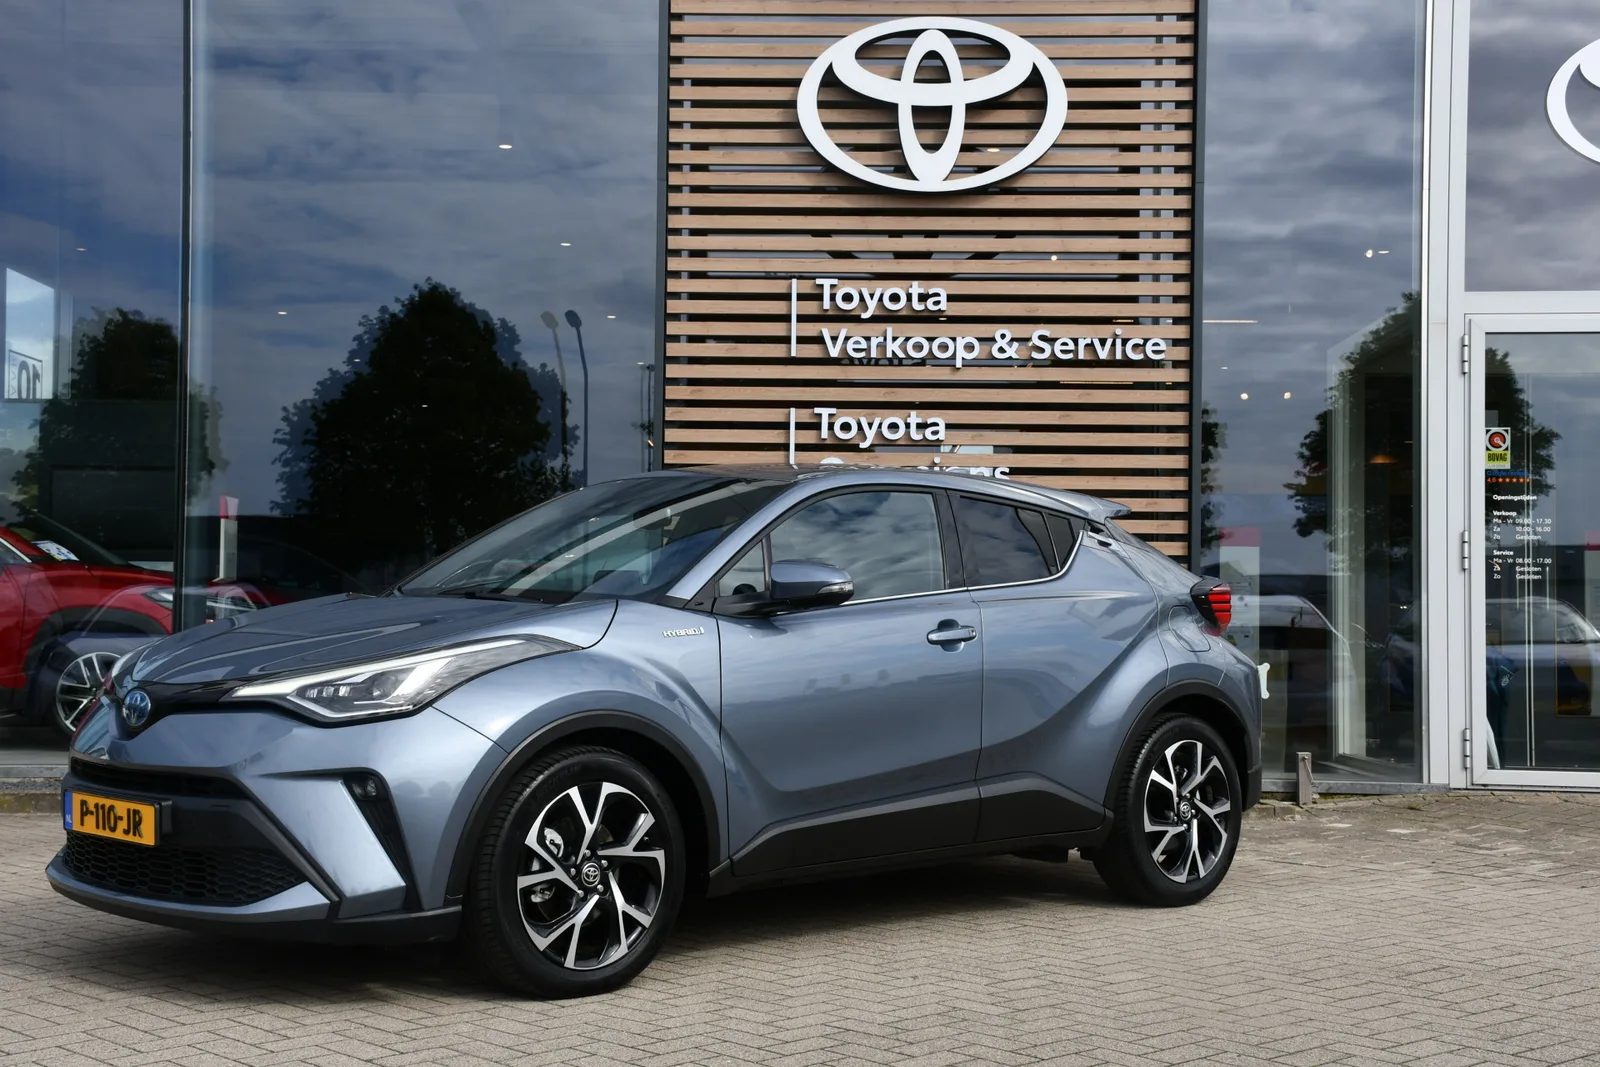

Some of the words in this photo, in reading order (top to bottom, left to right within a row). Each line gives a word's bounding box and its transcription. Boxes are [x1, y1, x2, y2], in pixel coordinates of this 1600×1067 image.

[815, 278, 948, 319] Toyota
[821, 327, 980, 368] Verkoop
[991, 329, 1019, 359] &
[1031, 328, 1167, 361] Service
[814, 407, 946, 448] Toyota
[1487, 453, 1508, 462] BOVAG
[662, 628, 699, 638] HYBRID
[80, 799, 143, 838] P-110-JR
